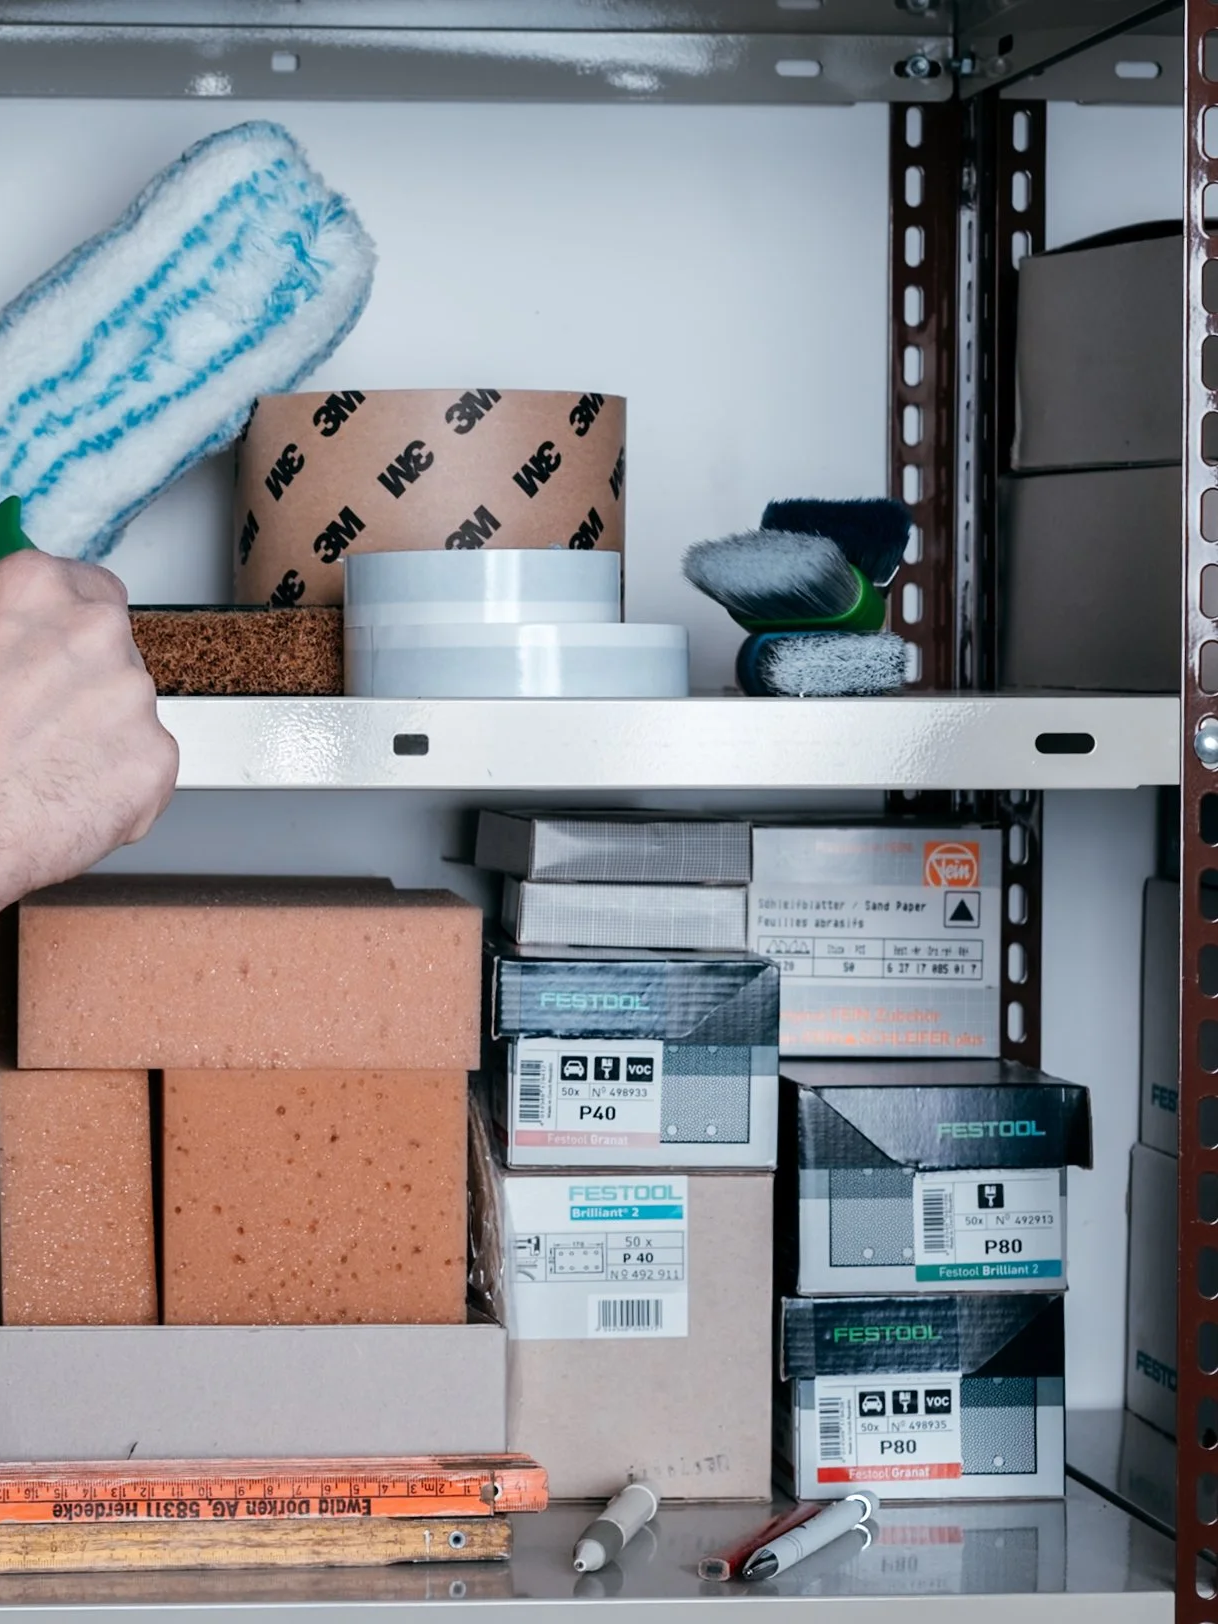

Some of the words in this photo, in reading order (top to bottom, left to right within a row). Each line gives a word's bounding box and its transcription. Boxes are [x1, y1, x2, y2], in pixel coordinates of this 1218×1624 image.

[313, 390, 366, 437] 3M
[445, 388, 501, 434] 3M
[569, 392, 605, 437] 3M
[265, 443, 305, 500] 3M
[377, 440, 434, 498] 3M
[512, 440, 562, 498] 3M
[445, 504, 501, 550] 3M
[568, 507, 605, 550] 3M
[313, 505, 366, 564] 3M
[865, 900, 890, 913] Sand
[896, 900, 927, 914] Paper
[540, 991, 651, 1011] FESTOOL
[628, 1064, 653, 1076] VOC
[561, 1087, 580, 1097] 50x
[609, 1087, 648, 1098] 498933
[579, 1105, 617, 1121] P40
[937, 1120, 1047, 1139] FESTOOL
[547, 1133, 588, 1146] Festool
[590, 1134, 629, 1147] Granat
[569, 1184, 684, 1202] FESTOOL
[631, 1207, 640, 1218] 2
[965, 1216, 984, 1227] 50x
[1015, 1214, 1054, 1226] 492913
[625, 1236, 641, 1248] 50
[645, 1239, 653, 1248] x
[984, 1238, 1023, 1255] P80
[623, 1253, 631, 1264] P
[636, 1252, 654, 1264] 40
[632, 1269, 654, 1280] 492
[658, 1268, 680, 1280] 911
[939, 1267, 980, 1278] Festool
[982, 1265, 1029, 1276] Brilliant
[1032, 1264, 1039, 1274] 2
[834, 1325, 942, 1343] FESTOOL
[926, 1396, 950, 1407] VOC
[861, 1422, 880, 1432] 50x
[908, 1419, 947, 1431] 498935
[880, 1440, 917, 1455] P80
[849, 1467, 889, 1480] Festool
[891, 1467, 930, 1478] Granat
[238, 1485, 245, 1496] 9
[266, 1485, 274, 1496] 8
[353, 1485, 360, 1495] 5
[382, 1485, 389, 1494] 4
[410, 1484, 417, 1494] 3
[438, 1483, 445, 1494] 2
[52, 1501, 138, 1520] Herdecke
[146, 1500, 201, 1518] 58311
[318, 1498, 372, 1516] Ewald
